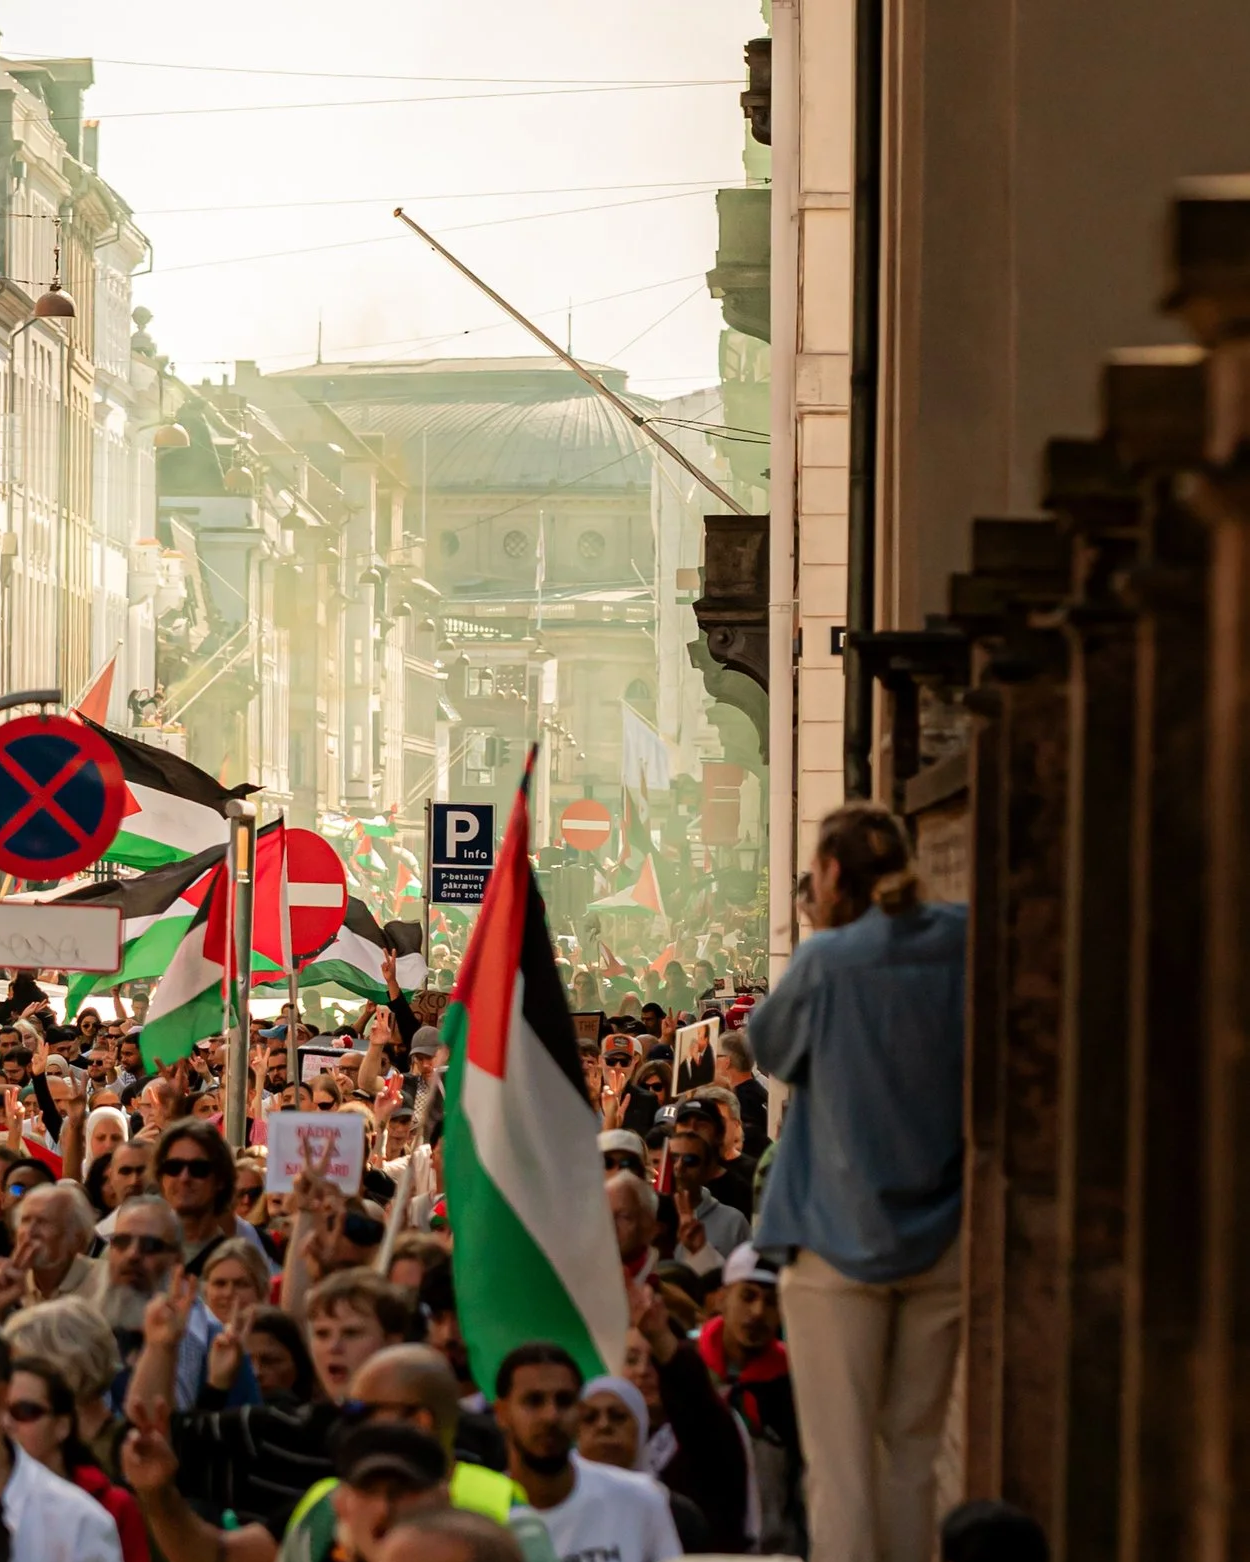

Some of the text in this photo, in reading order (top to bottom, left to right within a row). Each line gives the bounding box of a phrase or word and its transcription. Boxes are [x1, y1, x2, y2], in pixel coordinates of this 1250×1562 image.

[446, 811, 480, 858] P
[464, 849, 488, 859] Info
[441, 873, 485, 882] P-betaling
[442, 882, 483, 890] påkrævet
